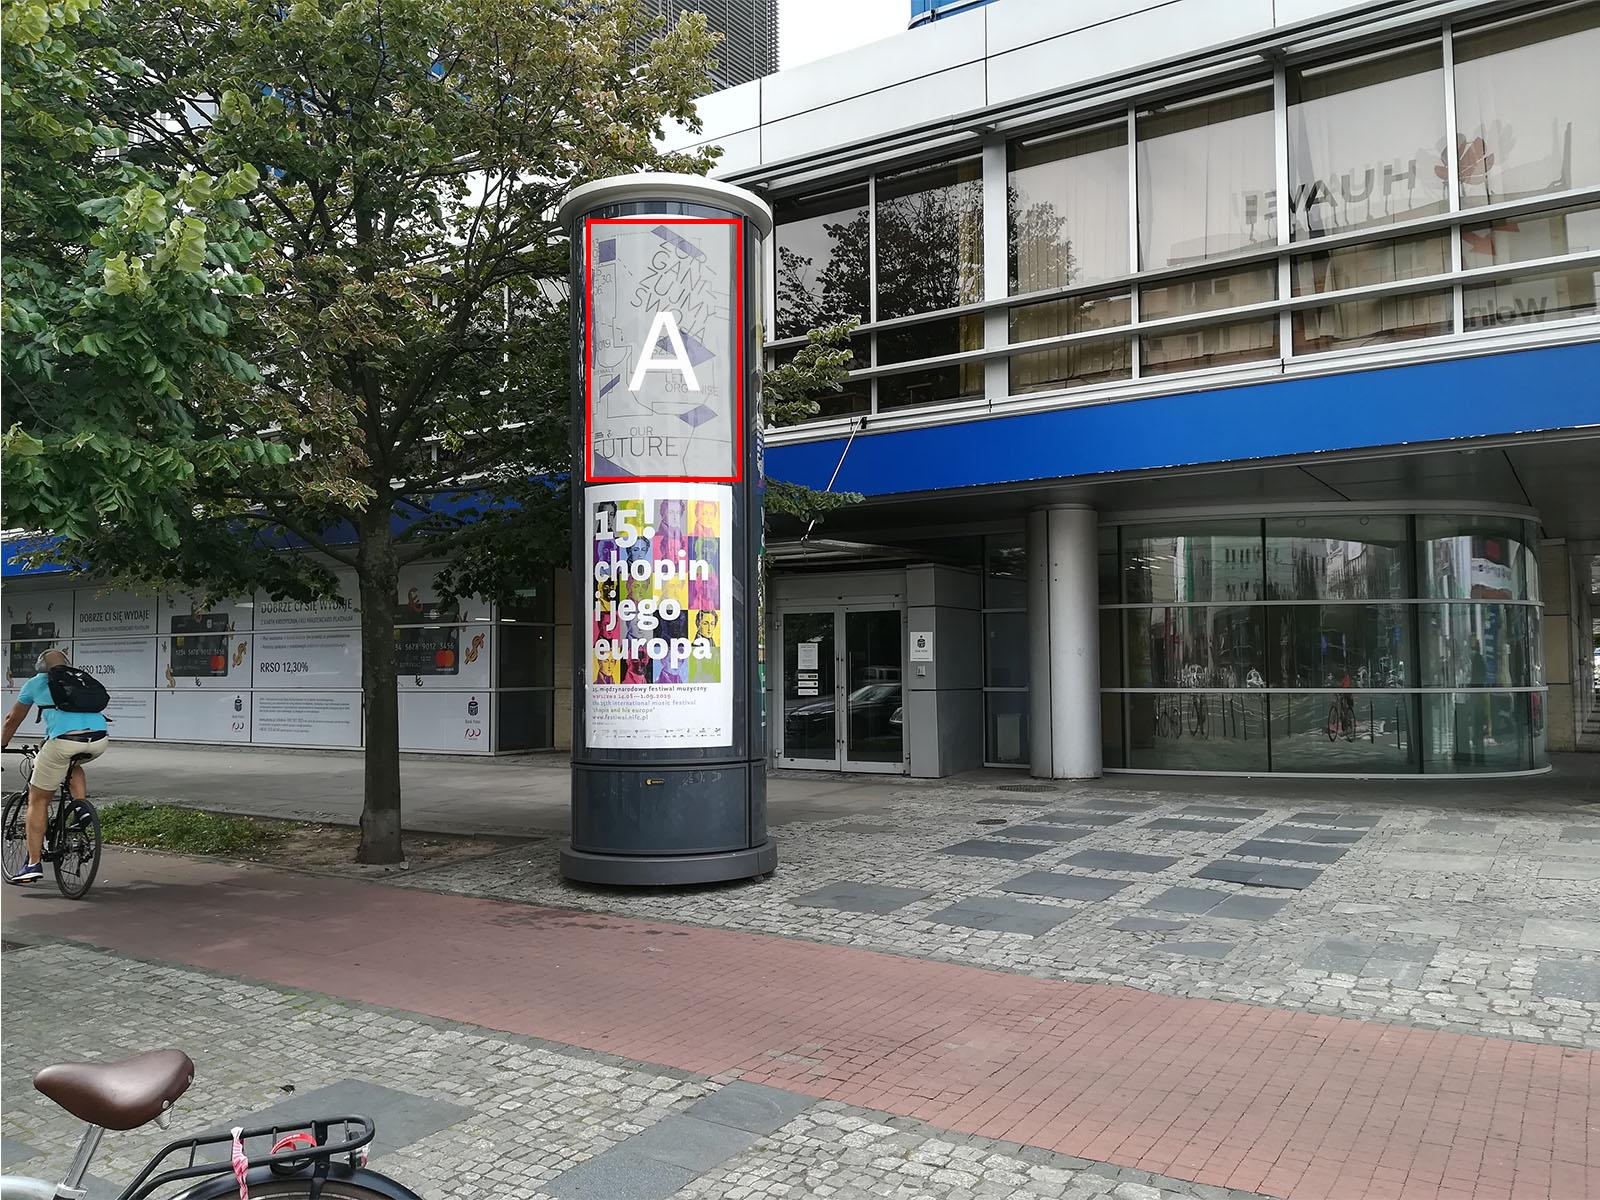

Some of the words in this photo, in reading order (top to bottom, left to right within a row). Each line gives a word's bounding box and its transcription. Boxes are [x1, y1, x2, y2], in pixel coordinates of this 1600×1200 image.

[665, 382, 720, 397] ORGNISE
[629, 426, 654, 437] OUR
[593, 436, 679, 460] FUTURE
[594, 500, 656, 549] 15!
[594, 550, 709, 590] chopin
[260, 601, 292, 614] DOBRZE
[294, 600, 303, 613] CI
[594, 591, 602, 622] i
[606, 590, 681, 631] jego
[80, 612, 103, 623] DOBRZE
[105, 611, 112, 622] CI
[112, 610, 123, 624] SIĘ
[123, 609, 150, 622] WYDAJE
[594, 635, 713, 669] europa
[95, 664, 116, 677] 12,30%
[260, 662, 281, 673] RRSO
[282, 661, 309, 674] 12,30%
